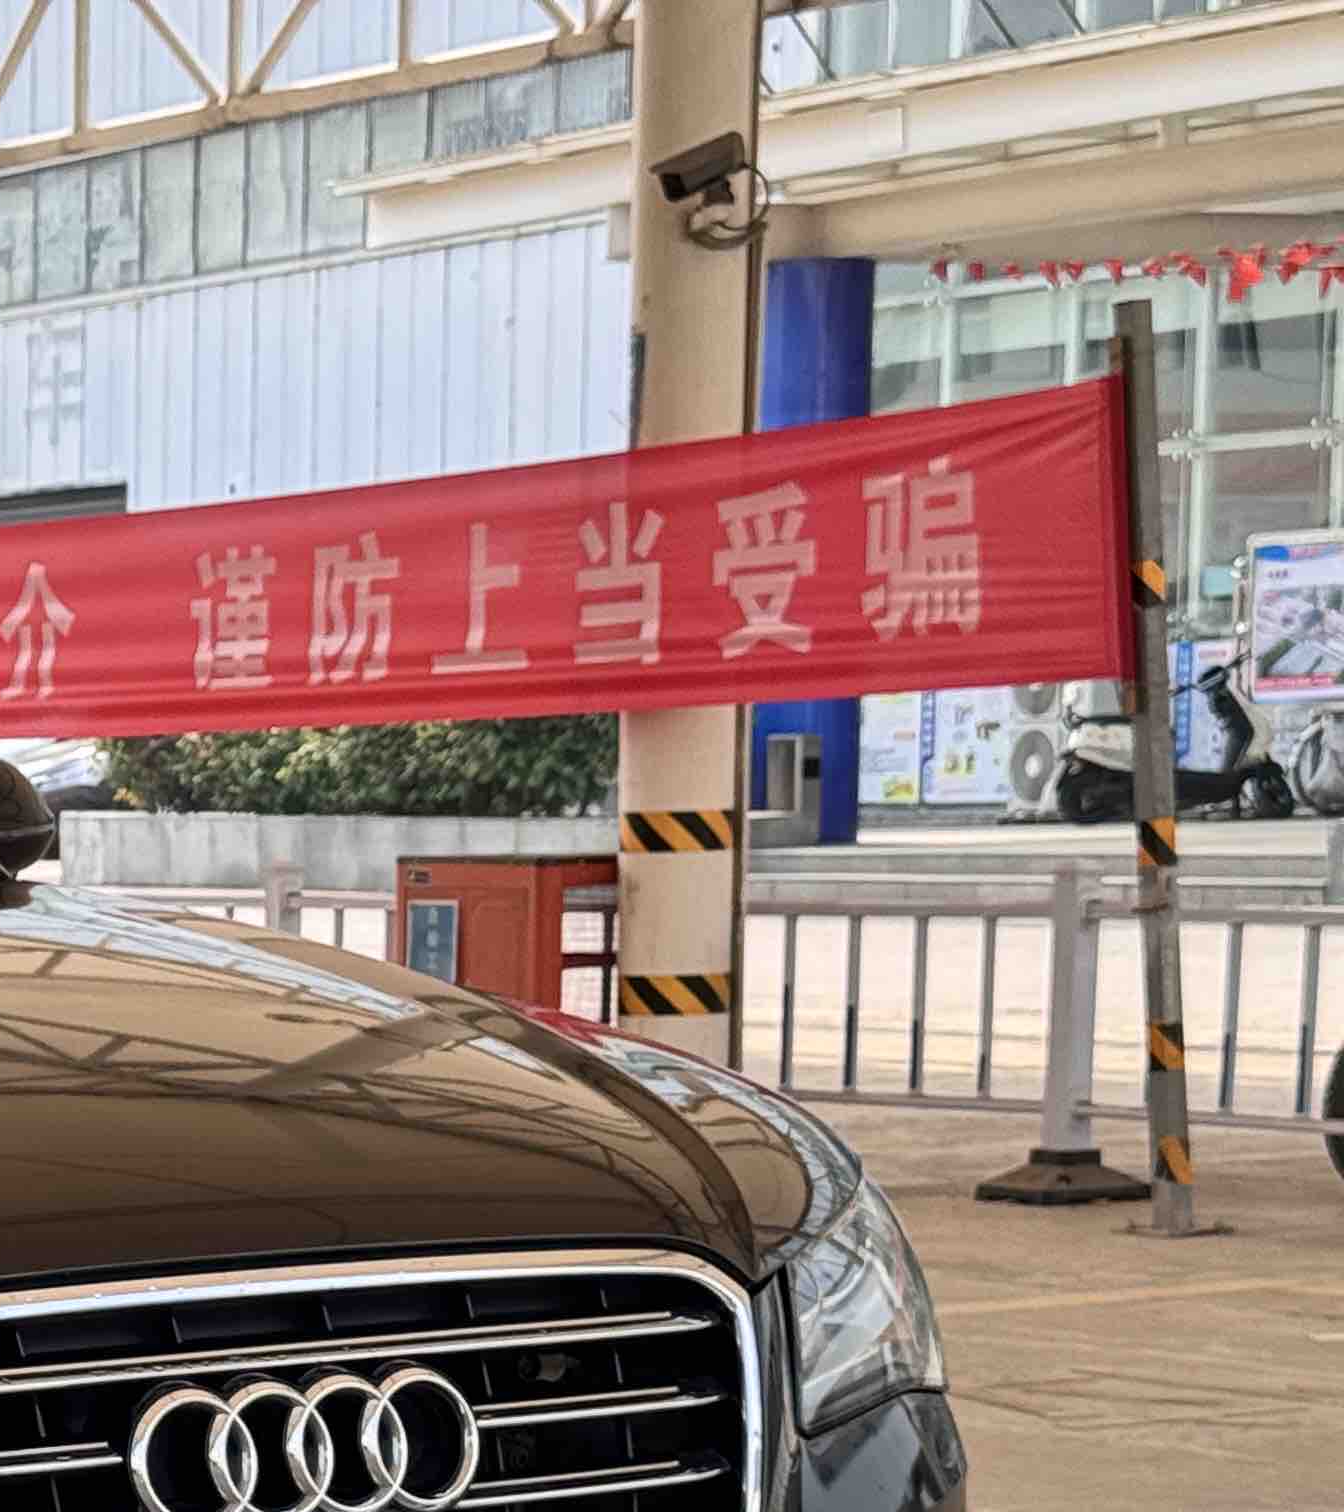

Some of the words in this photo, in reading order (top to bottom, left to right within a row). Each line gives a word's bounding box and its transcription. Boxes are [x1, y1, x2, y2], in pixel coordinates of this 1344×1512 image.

[190, 455, 983, 692] 谨防上当受骗
